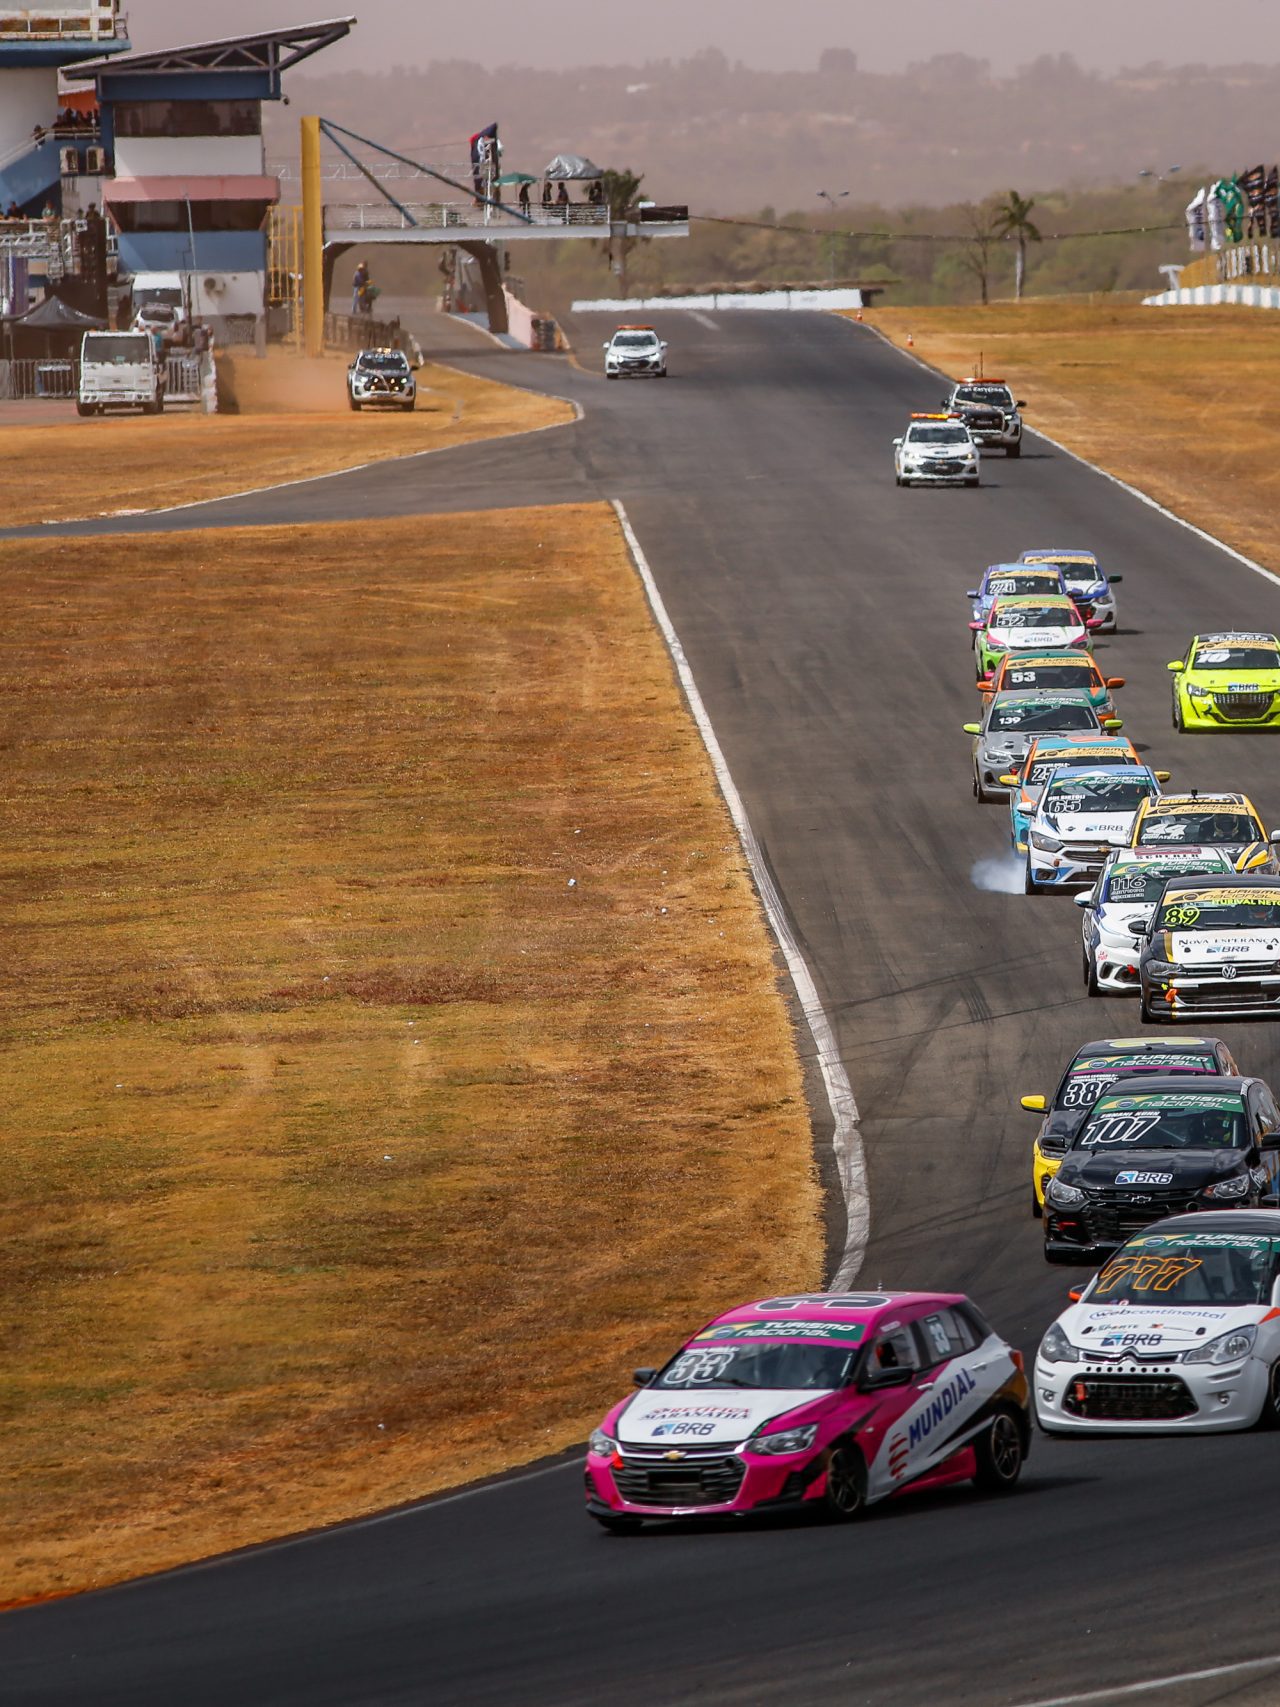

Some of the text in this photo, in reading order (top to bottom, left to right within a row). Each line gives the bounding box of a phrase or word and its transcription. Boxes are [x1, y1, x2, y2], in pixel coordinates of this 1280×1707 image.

[1011, 671, 1036, 683] 53
[999, 717, 1022, 725] 139
[1048, 799, 1082, 814] 65
[1098, 824, 1124, 832] BRB
[1110, 875, 1147, 891] 116
[1164, 906, 1201, 927] 89
[1221, 945, 1250, 953] BRB
[1132, 1054, 1209, 1062] TURISMO
[1160, 1095, 1241, 1104] TURISMO
[1081, 1115, 1162, 1145] 107
[1135, 1172, 1172, 1185] BRB
[1096, 1256, 1203, 1294] 777
[1093, 1308, 1227, 1321] webcontinental
[764, 1321, 857, 1332] TURISMO
[1121, 1333, 1163, 1346] BRB
[663, 1352, 736, 1385] 33
[909, 1367, 977, 1449] MUNDIAL
[671, 1422, 717, 1436] BRB
